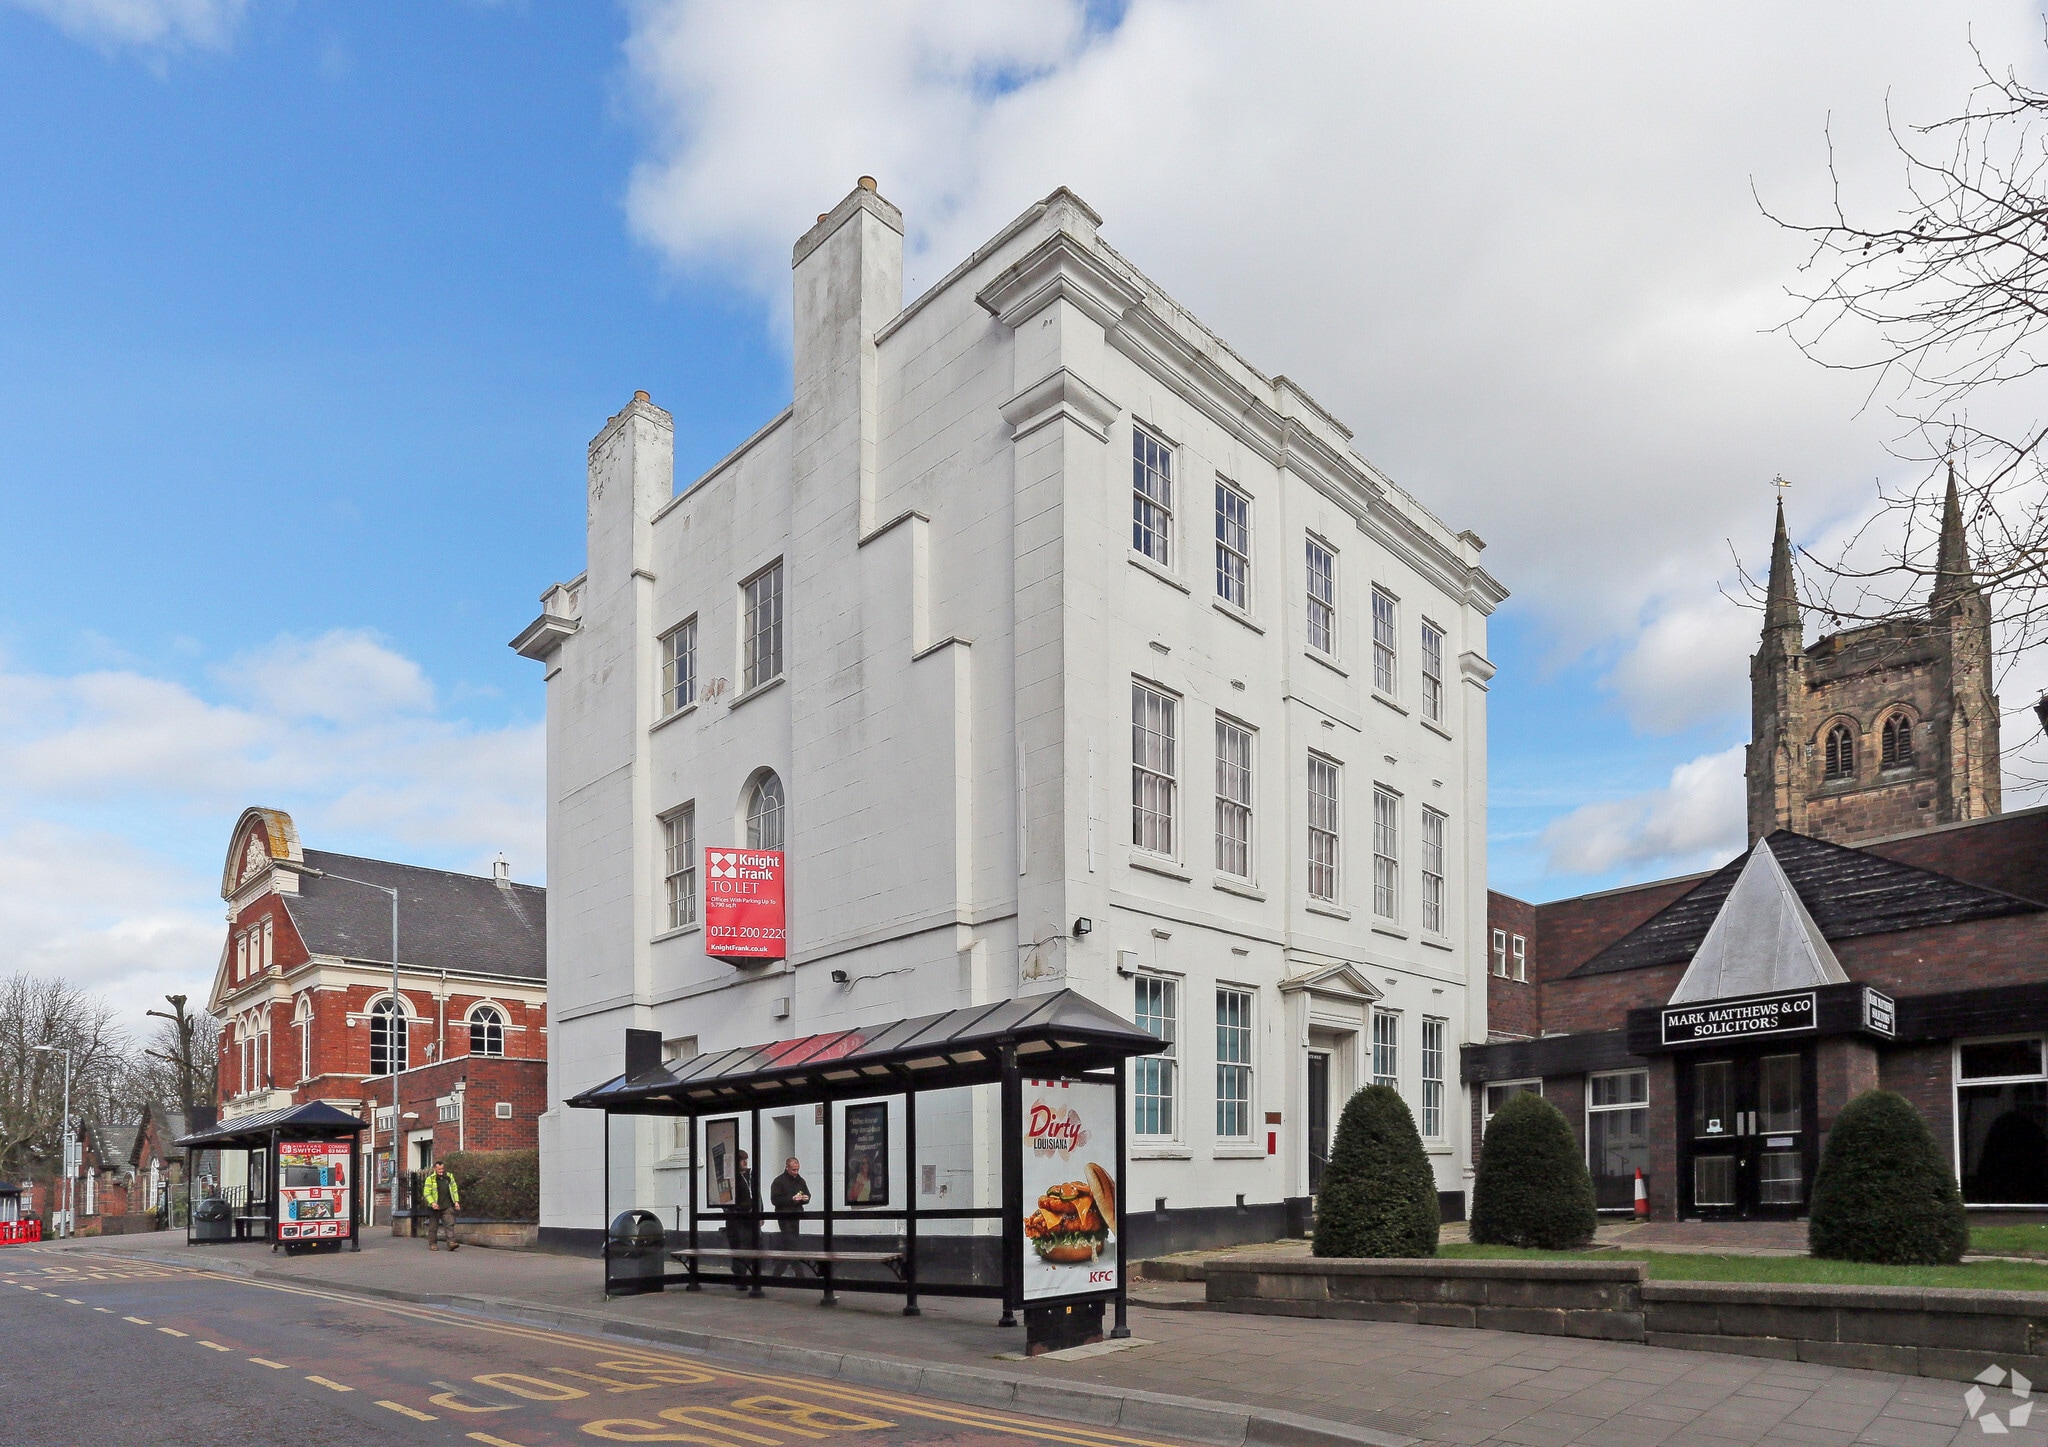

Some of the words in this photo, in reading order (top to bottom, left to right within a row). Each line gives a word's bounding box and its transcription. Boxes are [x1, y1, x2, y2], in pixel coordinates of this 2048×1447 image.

[739, 853, 780, 869] Knight
[739, 867, 773, 880] Frank
[711, 880, 732, 893] TO
[735, 881, 759, 894] LET
[711, 925, 738, 937] 0121
[740, 926, 760, 938] 200
[710, 943, 768, 952] KnightFrank.co.uk
[1668, 1012, 1705, 1027] MARK
[1708, 1003, 1779, 1022] MATTHEWS
[1781, 1002, 1793, 1014] &
[1793, 999, 1811, 1012] CO
[1694, 1016, 1779, 1036] SOLICITORS
[1029, 1104, 1082, 1152] Dirty
[1033, 1138, 1068, 1150] LOUISIANA
[1088, 1270, 1114, 1283] KFC
[428, 1360, 717, 1413] STOP
